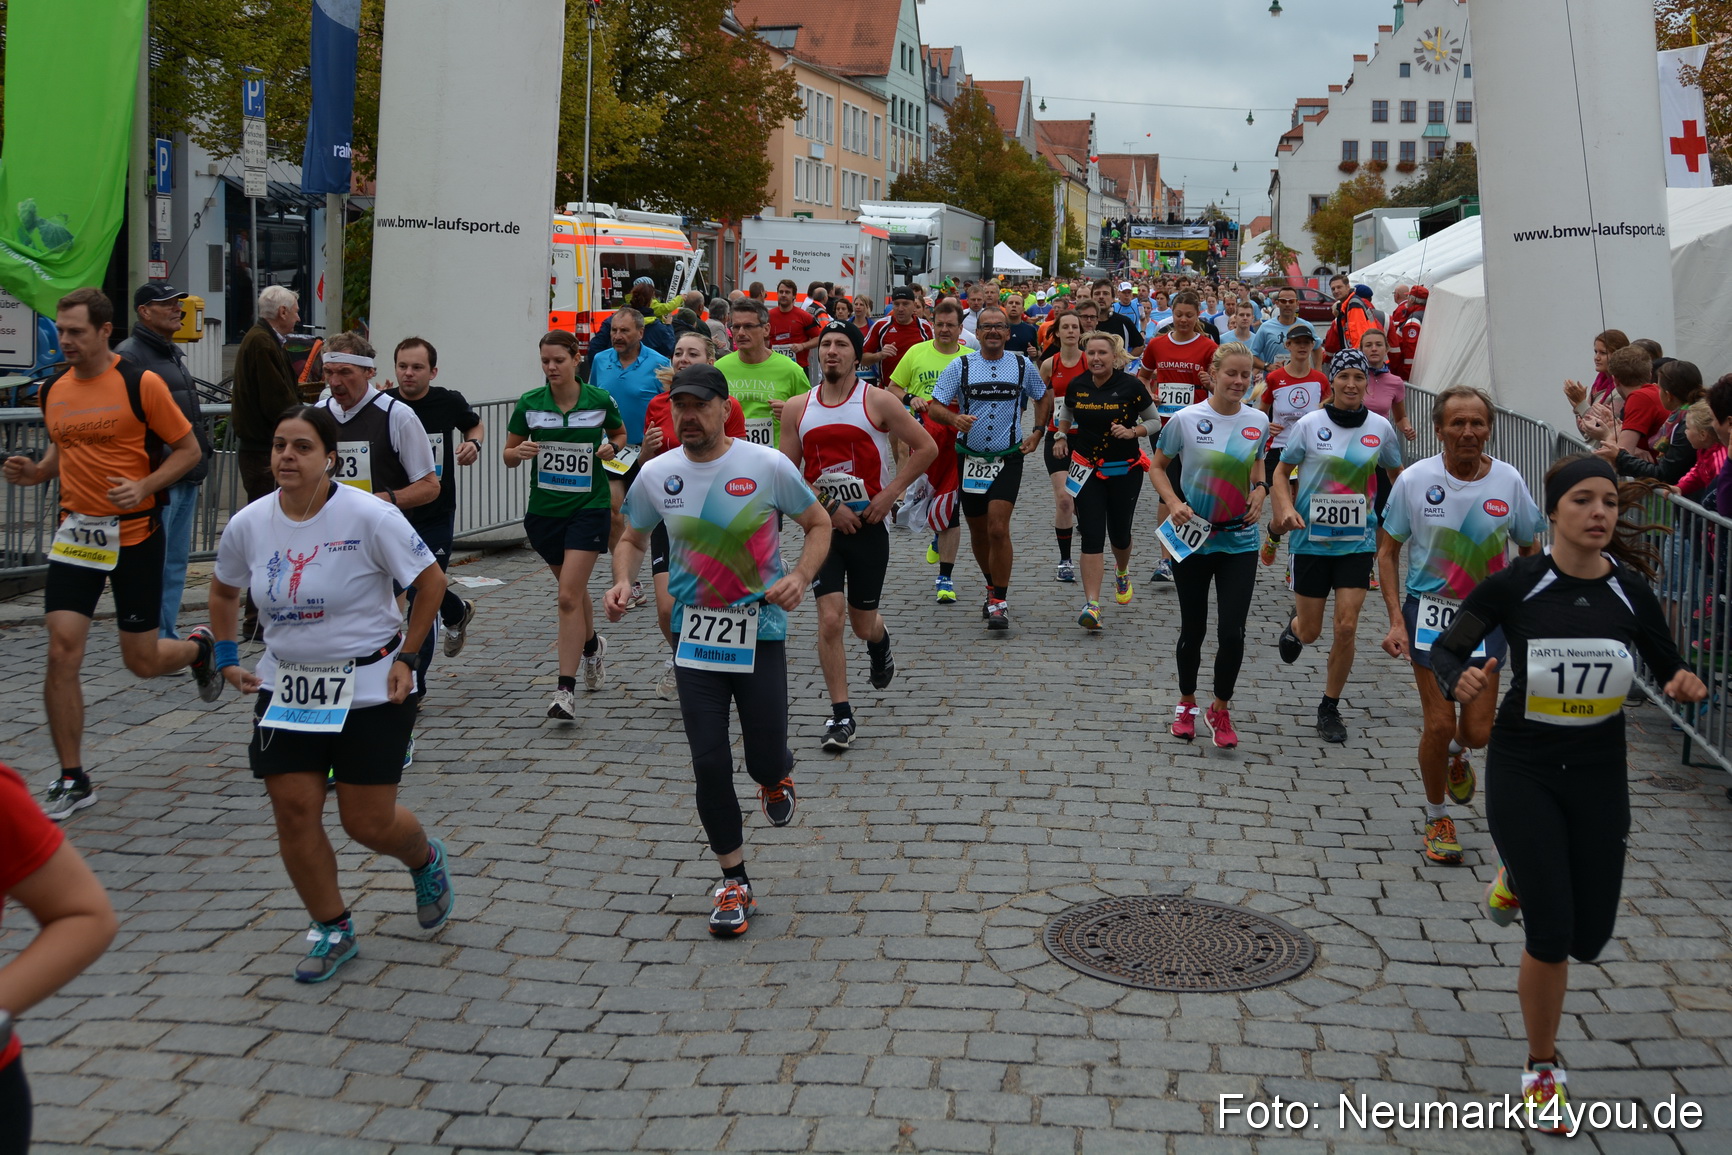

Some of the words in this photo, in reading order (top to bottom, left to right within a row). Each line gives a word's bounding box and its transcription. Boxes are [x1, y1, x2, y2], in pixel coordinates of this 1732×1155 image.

[247, 80, 260, 110] P
[160, 147, 168, 186] P
[194, 212, 201, 229] 3
[376, 215, 521, 234] www.bmw-laufsport.de
[1513, 222, 1666, 242] www.bmw-laufsport.de
[1154, 241, 1182, 249] START
[792, 250, 831, 258] Bayerisches
[1157, 361, 1194, 369] NEUMARKT
[728, 379, 775, 391] NOVINA
[1075, 401, 1119, 410] Marathon-Team
[1161, 391, 1191, 405] 2160
[543, 452, 589, 473] 2596
[967, 462, 1000, 478] 2823
[551, 475, 577, 485] Andrea
[1316, 506, 1360, 525] 2801
[1422, 594, 1446, 605] PARTL
[688, 613, 748, 645] 2721
[694, 647, 736, 662] Matthias
[1530, 649, 1564, 658] PARTL
[1567, 648, 1615, 658] Neumarkt
[299, 663, 340, 673] Neumarkt
[1551, 662, 1613, 694] 177
[281, 675, 346, 705] 3047
[1562, 702, 1594, 715] Lena
[278, 709, 333, 725] ANGELA
